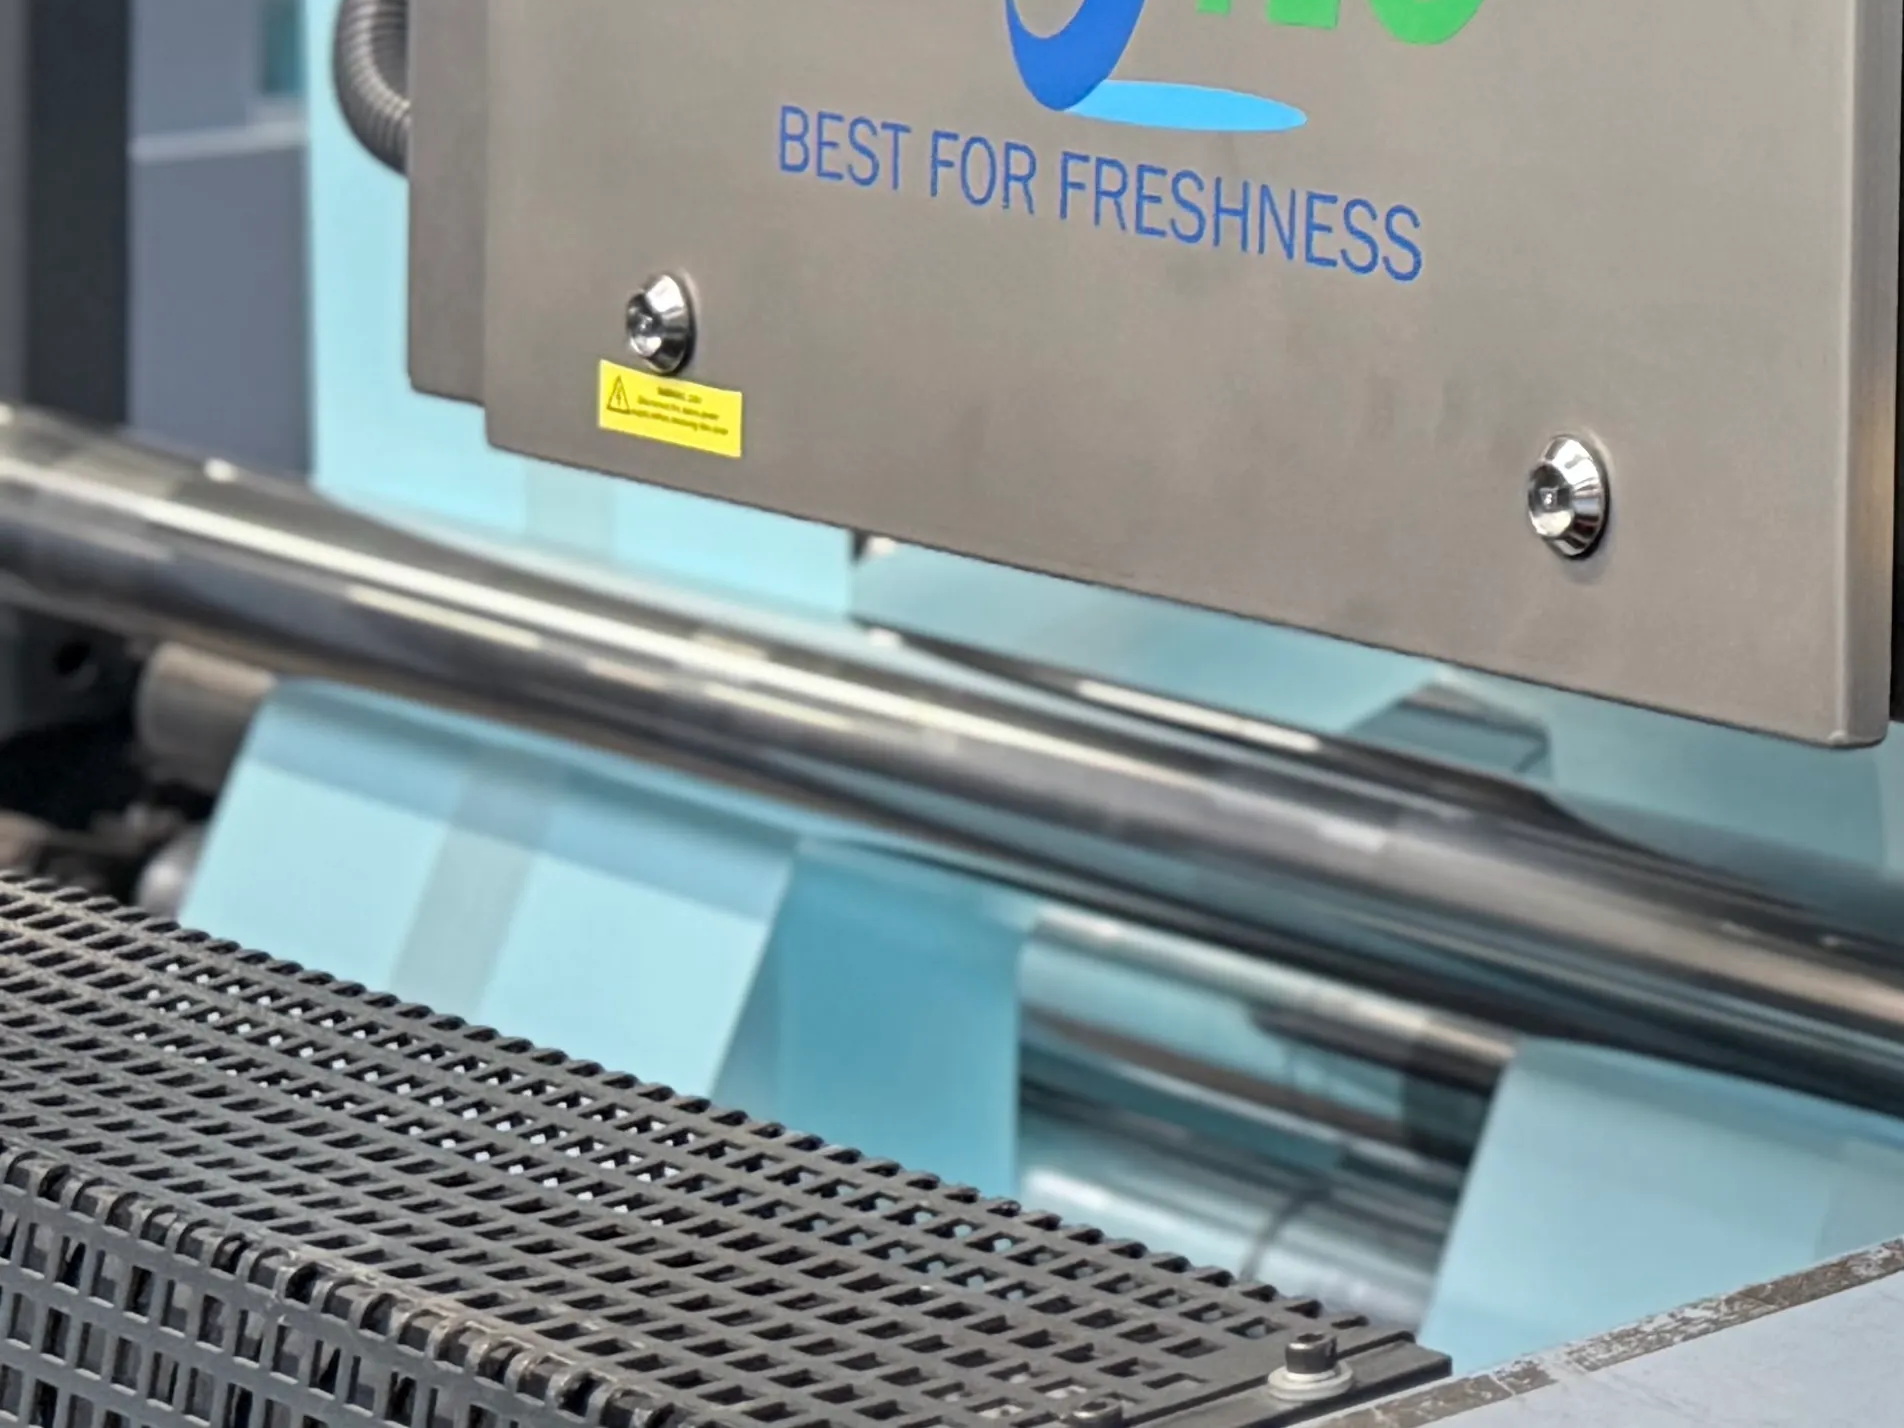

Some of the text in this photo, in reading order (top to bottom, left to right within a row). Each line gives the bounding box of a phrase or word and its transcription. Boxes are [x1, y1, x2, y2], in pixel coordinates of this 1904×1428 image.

[779, 104, 1423, 283] BEST FOR FRESHNESS
